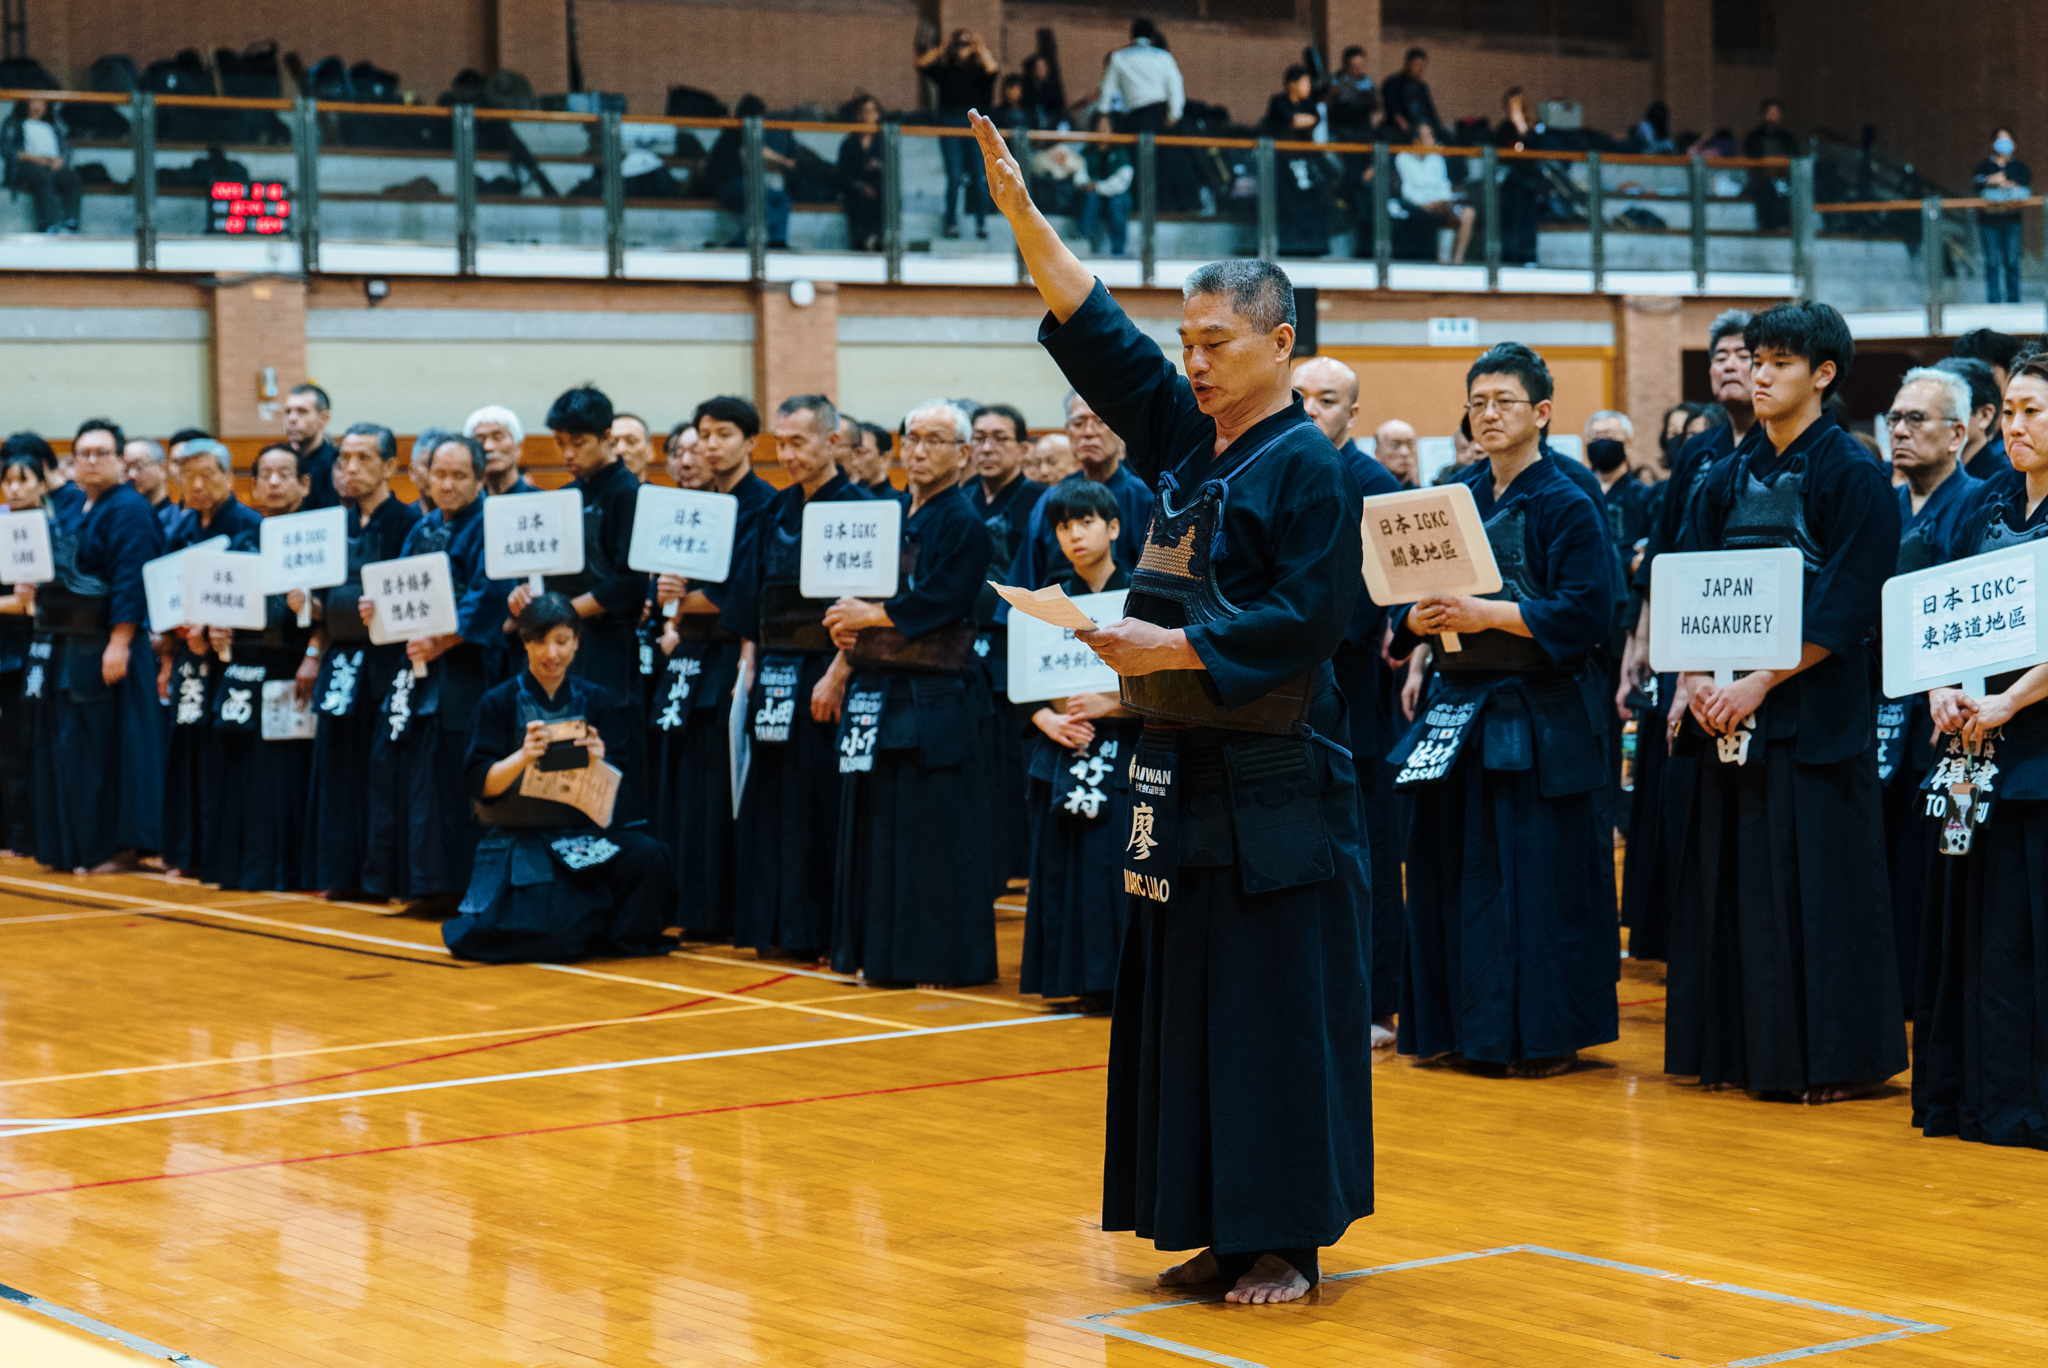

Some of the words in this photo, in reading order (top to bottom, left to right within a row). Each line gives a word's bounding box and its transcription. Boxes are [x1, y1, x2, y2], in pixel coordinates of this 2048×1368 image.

[518, 513, 544, 531] 日本
[675, 508, 701, 528] 日本
[1379, 514, 1411, 535] 日本
[1413, 510, 1449, 530] IGKC
[824, 522, 847, 540] 日本
[851, 522, 876, 539] IGKC
[1702, 577, 1753, 597] JAPAN
[1923, 587, 1963, 615] 日本
[1681, 614, 1773, 635] HAGAKUREY
[1921, 606, 2027, 650] 東海道地區
[1131, 766, 1172, 786] TAIWAN
[1125, 801, 1159, 861] 廖
[1123, 868, 1147, 898] MARC
[1144, 874, 1170, 904] LIAO
